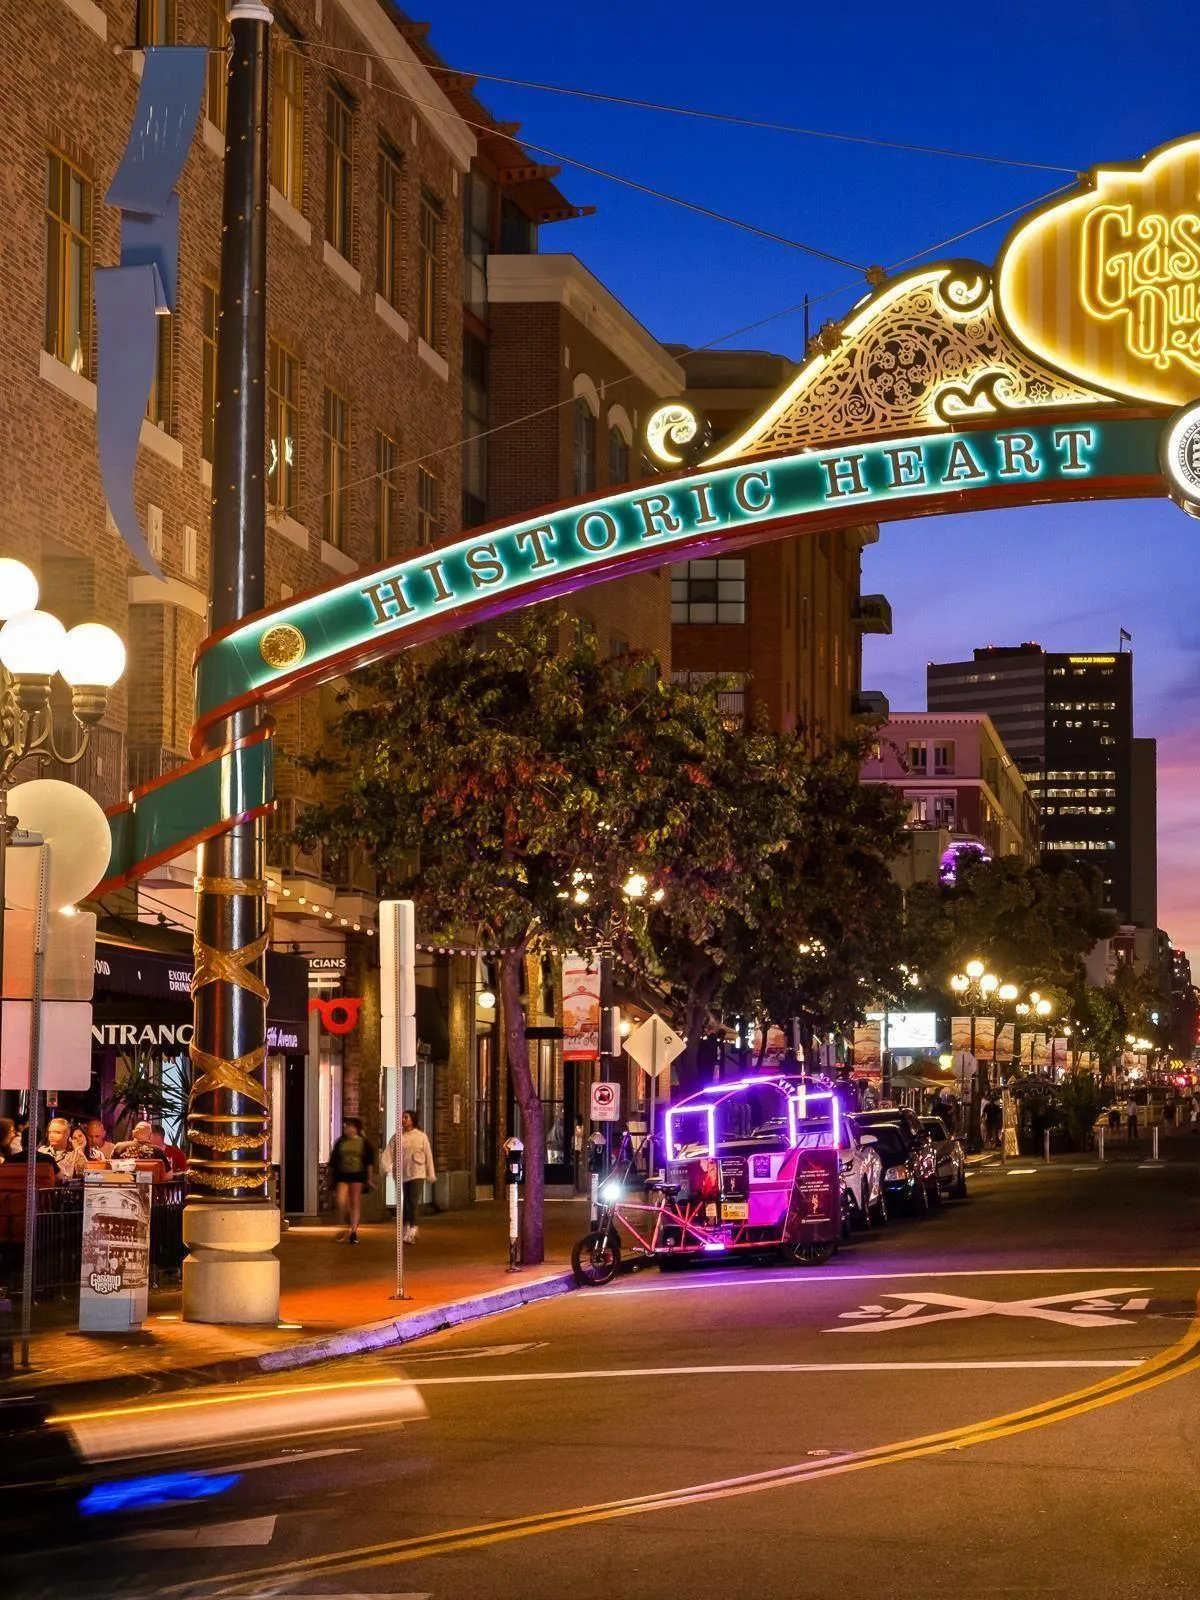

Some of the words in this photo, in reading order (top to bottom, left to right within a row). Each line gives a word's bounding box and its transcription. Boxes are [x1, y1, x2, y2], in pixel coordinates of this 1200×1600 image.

[361, 470, 773, 626] HISTORIC
[820, 429, 1092, 499] HEART
[93, 960, 110, 976] OOD
[308, 959, 346, 968] ICIANS
[92, 1024, 194, 1045] NTRANC
[277, 1028, 298, 1048] Avenue
